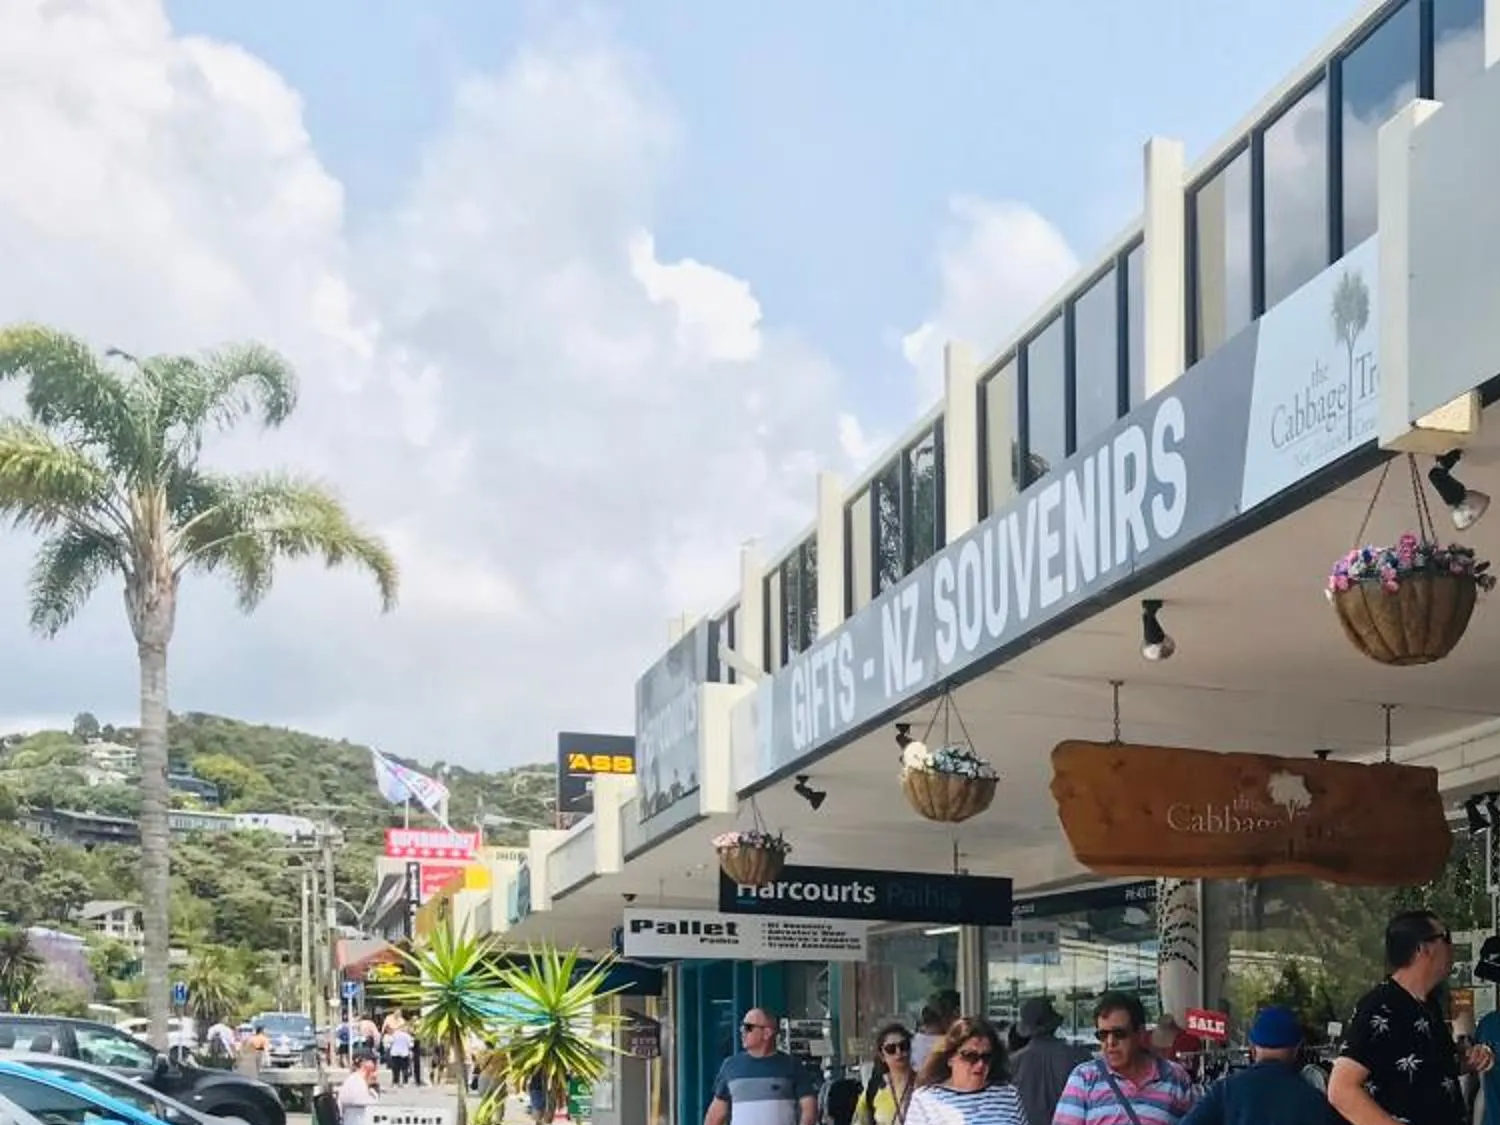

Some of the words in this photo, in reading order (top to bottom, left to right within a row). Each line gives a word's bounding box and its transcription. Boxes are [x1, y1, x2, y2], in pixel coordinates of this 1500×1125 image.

[1270, 383, 1347, 449] Cabbage
[1355, 351, 1380, 400] Tr
[790, 639, 856, 750] GIFTS
[881, 590, 924, 700] NZ
[933, 395, 1186, 665] SOUVENIRS
[568, 752, 633, 773] ASB
[736, 880, 877, 904] Harcourts
[630, 919, 739, 937] Pallet
[1188, 1015, 1225, 1035] SALE
